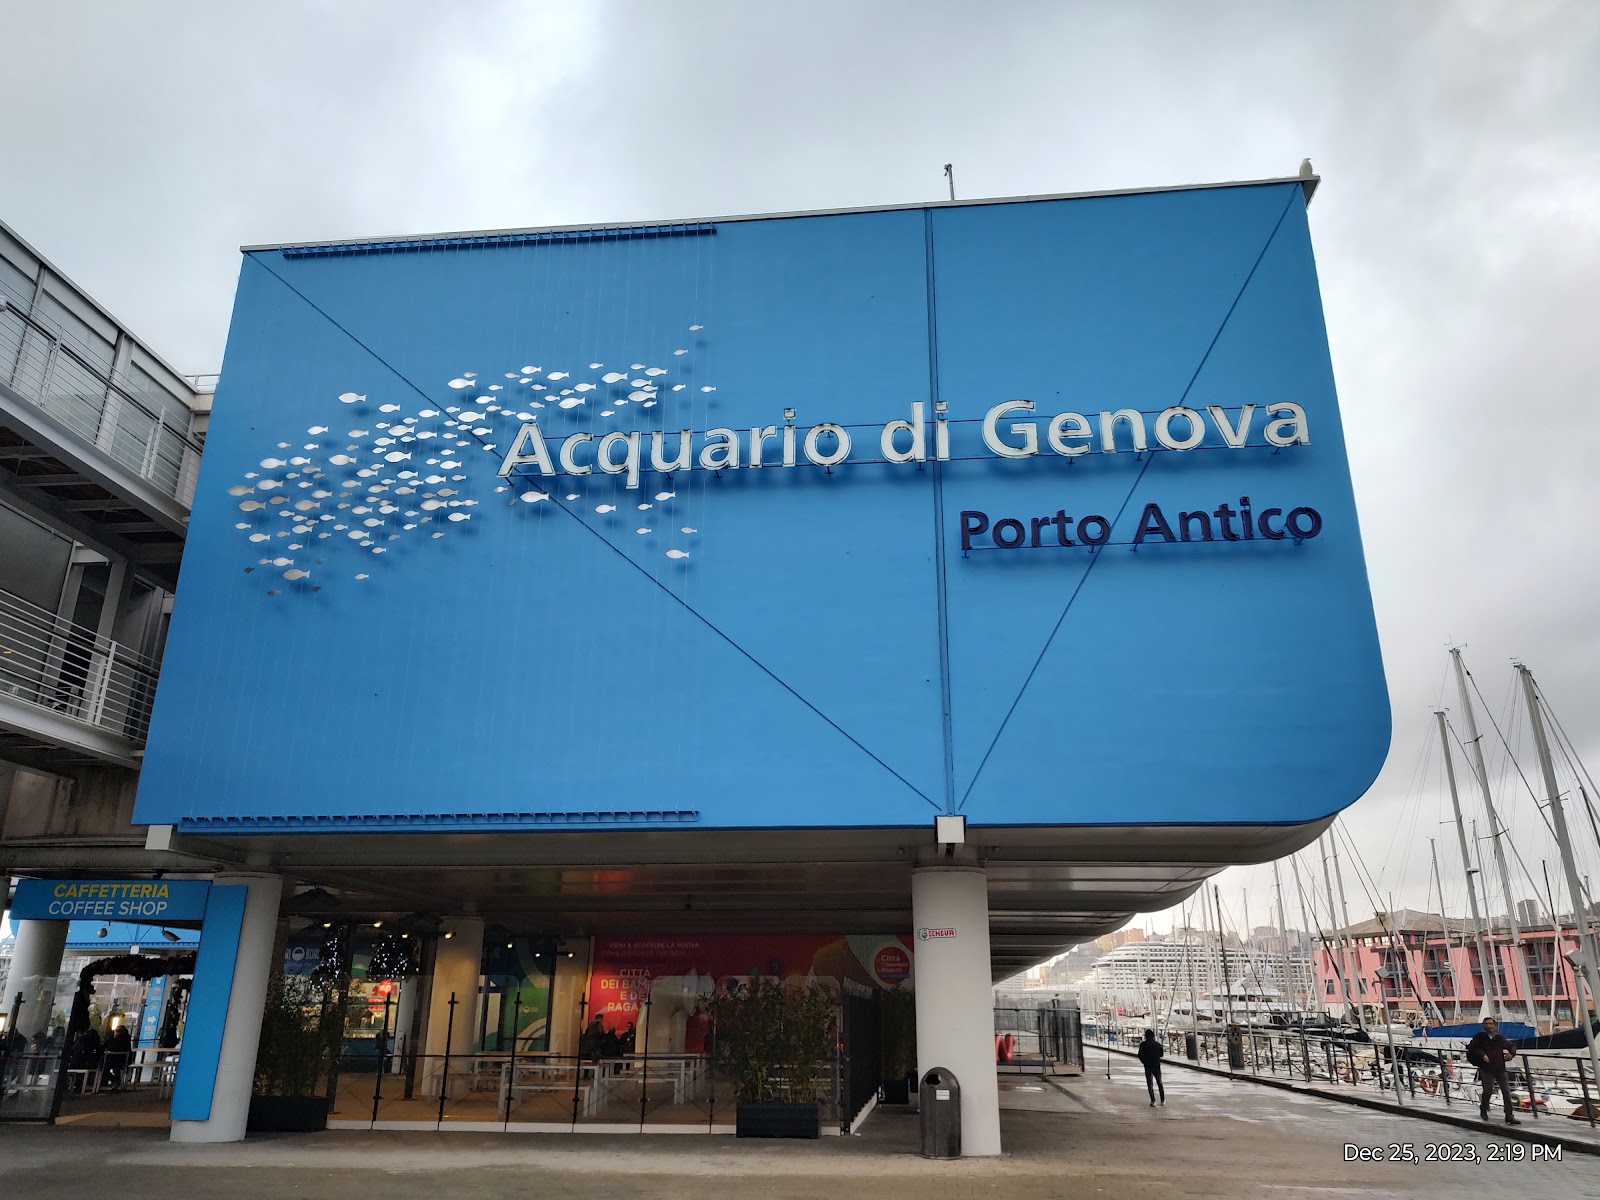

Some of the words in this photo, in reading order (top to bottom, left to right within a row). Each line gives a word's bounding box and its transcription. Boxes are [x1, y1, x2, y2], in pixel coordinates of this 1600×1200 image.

[495, 407, 852, 489] Acquario
[880, 400, 951, 465] di
[981, 398, 1311, 459] Genova
[959, 509, 1112, 551] Porto
[1133, 496, 1324, 543] Antico
[53, 883, 169, 899] CAFFETTERIA
[48, 900, 115, 916] COFFEE
[118, 900, 168, 916] SHOP
[619, 966, 651, 978] CITTÀ
[601, 979, 619, 989] DEI
[620, 991, 627, 1000] E
[630, 991, 647, 1000] DE
